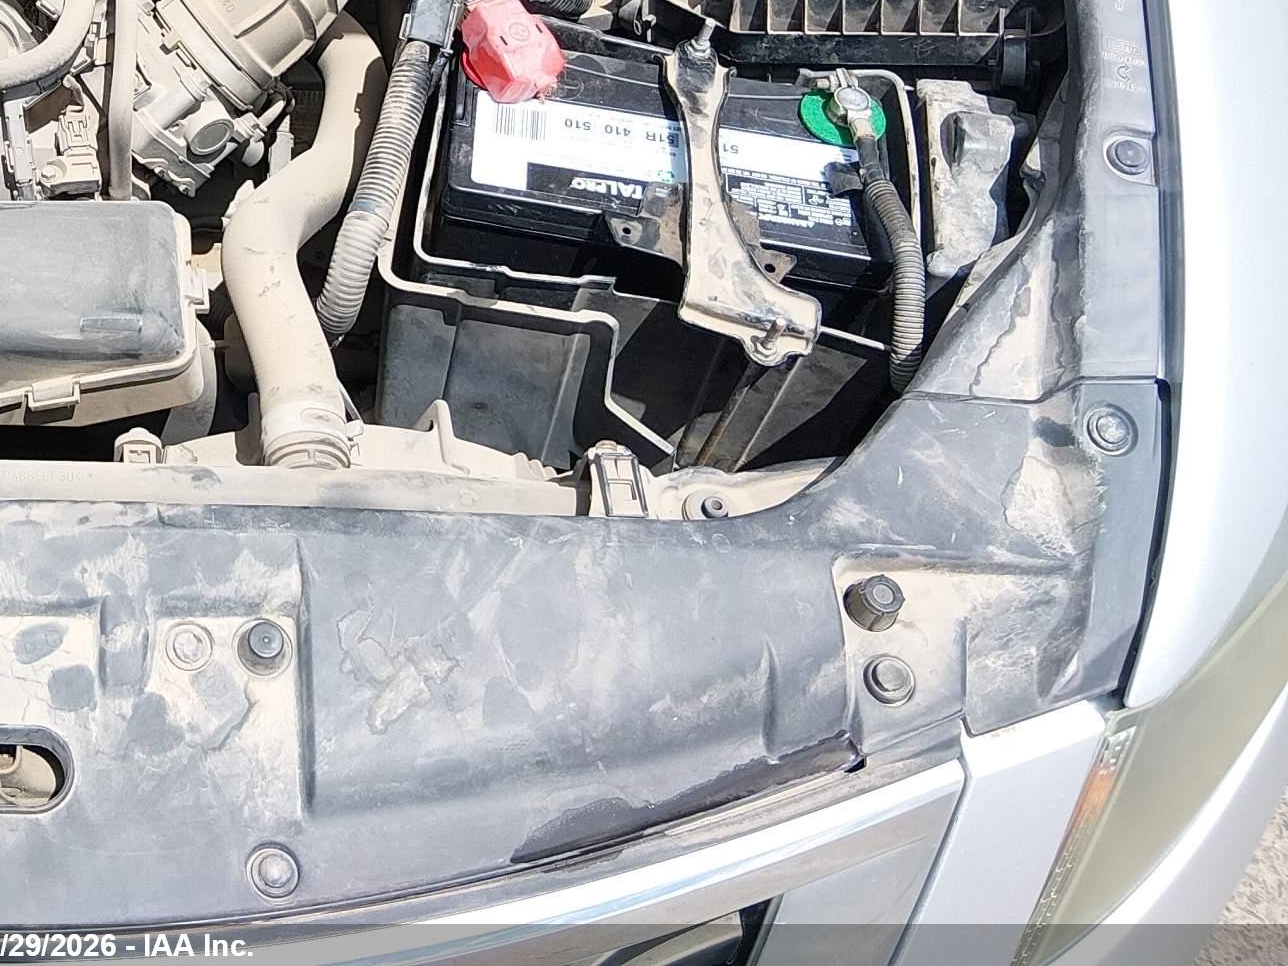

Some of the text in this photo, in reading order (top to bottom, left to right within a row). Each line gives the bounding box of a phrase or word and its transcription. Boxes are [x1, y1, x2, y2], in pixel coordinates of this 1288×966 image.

[564, 118, 675, 145] 51R 410 510
